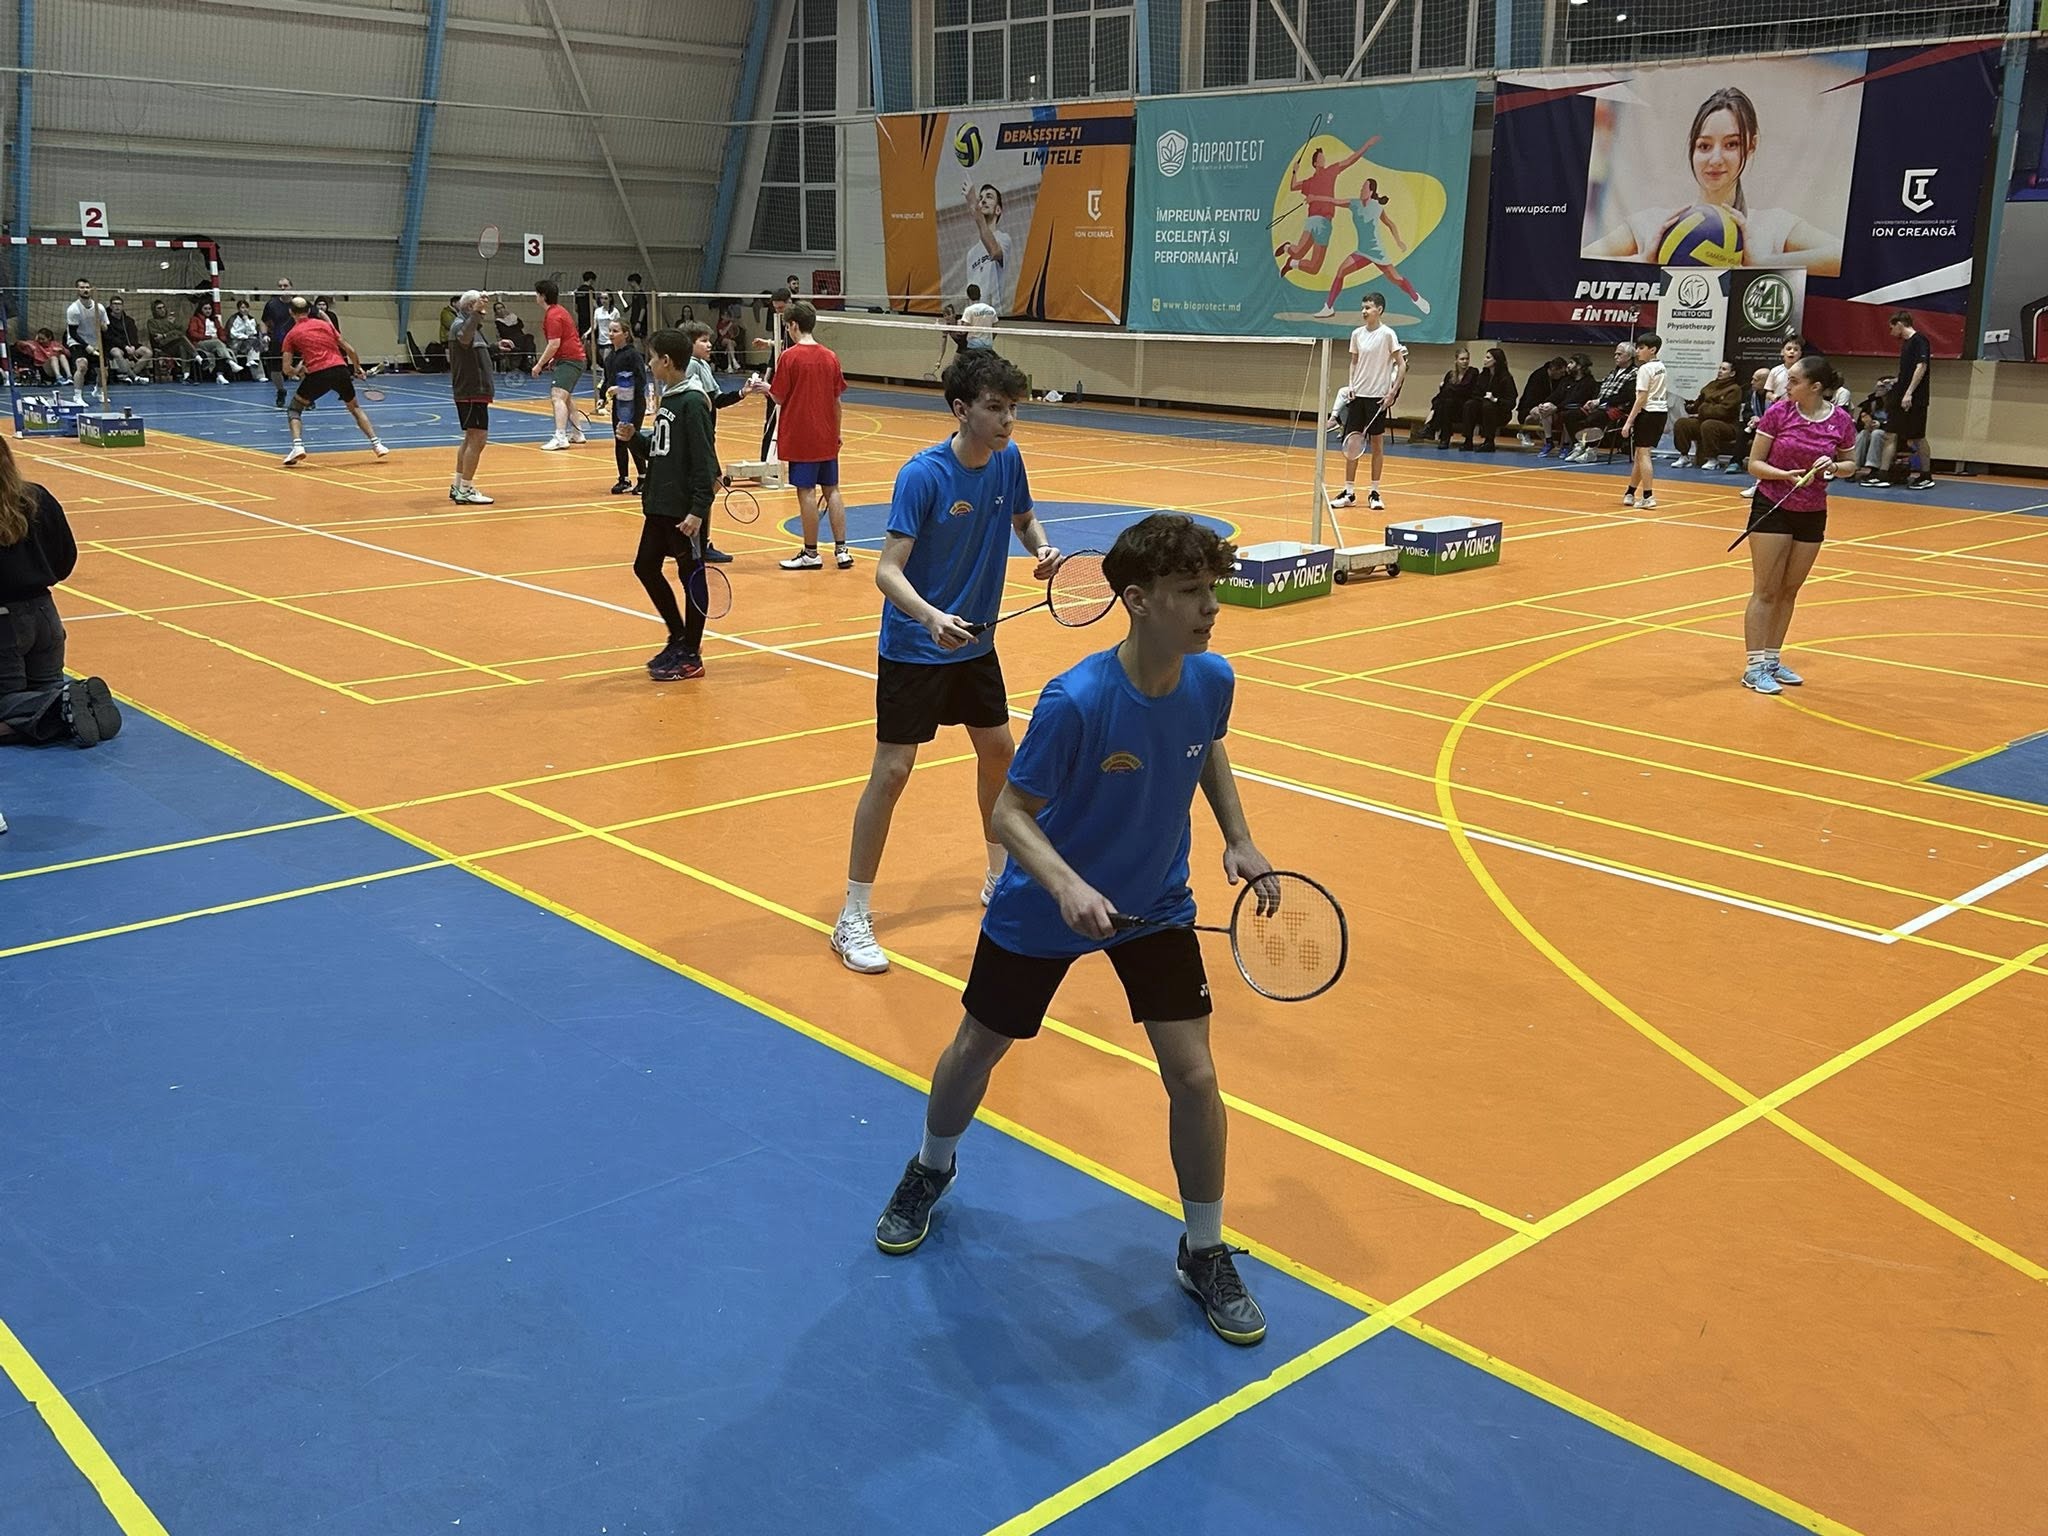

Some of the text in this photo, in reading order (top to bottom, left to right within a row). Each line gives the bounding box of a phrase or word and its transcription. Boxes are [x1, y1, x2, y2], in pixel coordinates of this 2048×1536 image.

[1023, 149, 1083, 166] LIMITELE
[1156, 206, 1261, 222] ÎMPREUNĂ PENTRU
[1505, 203, 1567, 215] www.upsc.md
[85, 207, 103, 228] 2
[1155, 228, 1230, 247] EXCELENȚĂ ȘI
[1872, 225, 1957, 237] ION CREANGĂ
[528, 239, 540, 257] 3
[1574, 281, 1661, 301] PUTERE
[1162, 301, 1241, 312] www.bioprotect.md
[1571, 308, 1584, 321] E
[1584, 305, 1602, 322] ÎN
[1672, 310, 1696, 318] KINETO
[1667, 322, 1716, 331] Physiotherapy
[1405, 546, 1430, 557] YONEX
[1464, 535, 1496, 558] YONEX
[1228, 577, 1254, 589] YONEX
[1292, 563, 1328, 589] YONEX
